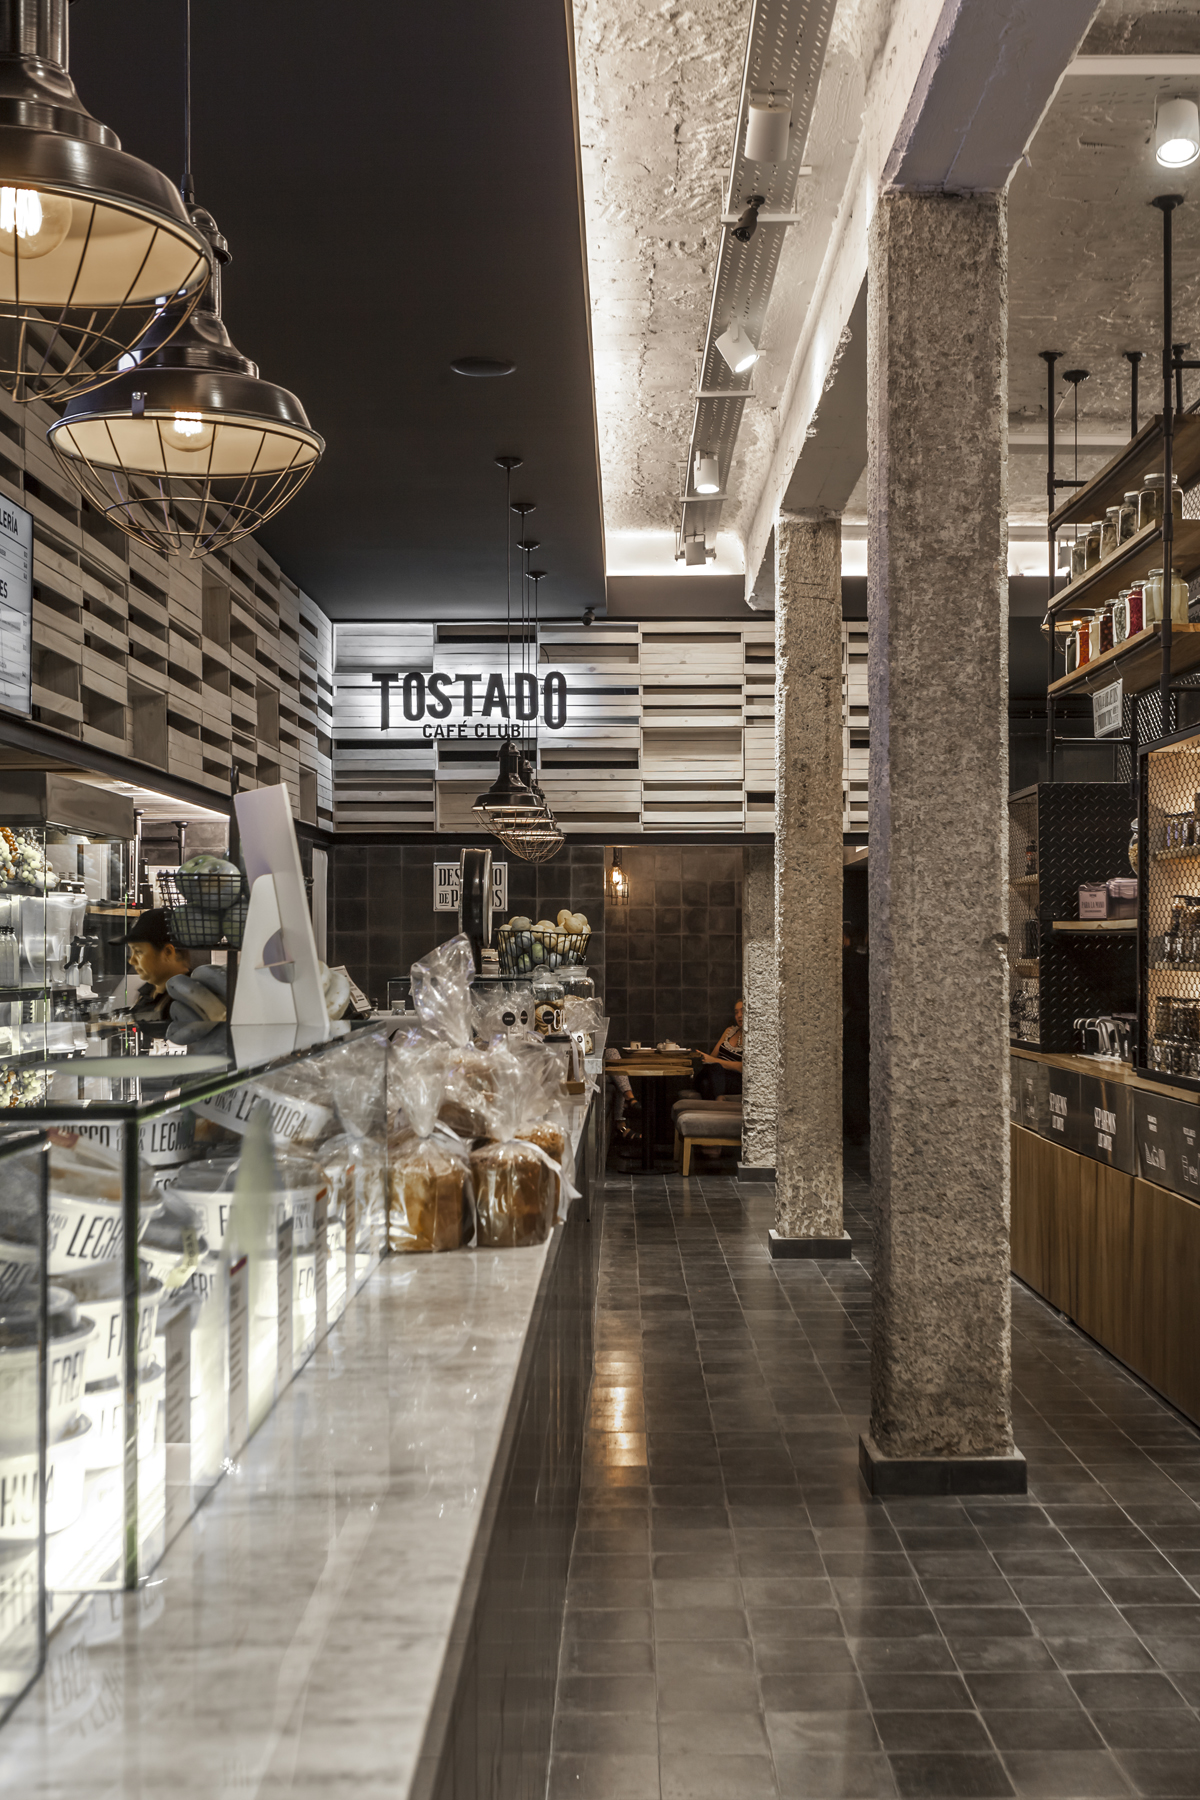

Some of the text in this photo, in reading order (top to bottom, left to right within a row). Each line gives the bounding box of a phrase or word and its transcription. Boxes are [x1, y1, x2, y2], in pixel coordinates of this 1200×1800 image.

[372, 671, 567, 731] TOSTADO
[422, 720, 521, 738] CAFÉ CLUB
[439, 892, 450, 904] DE
